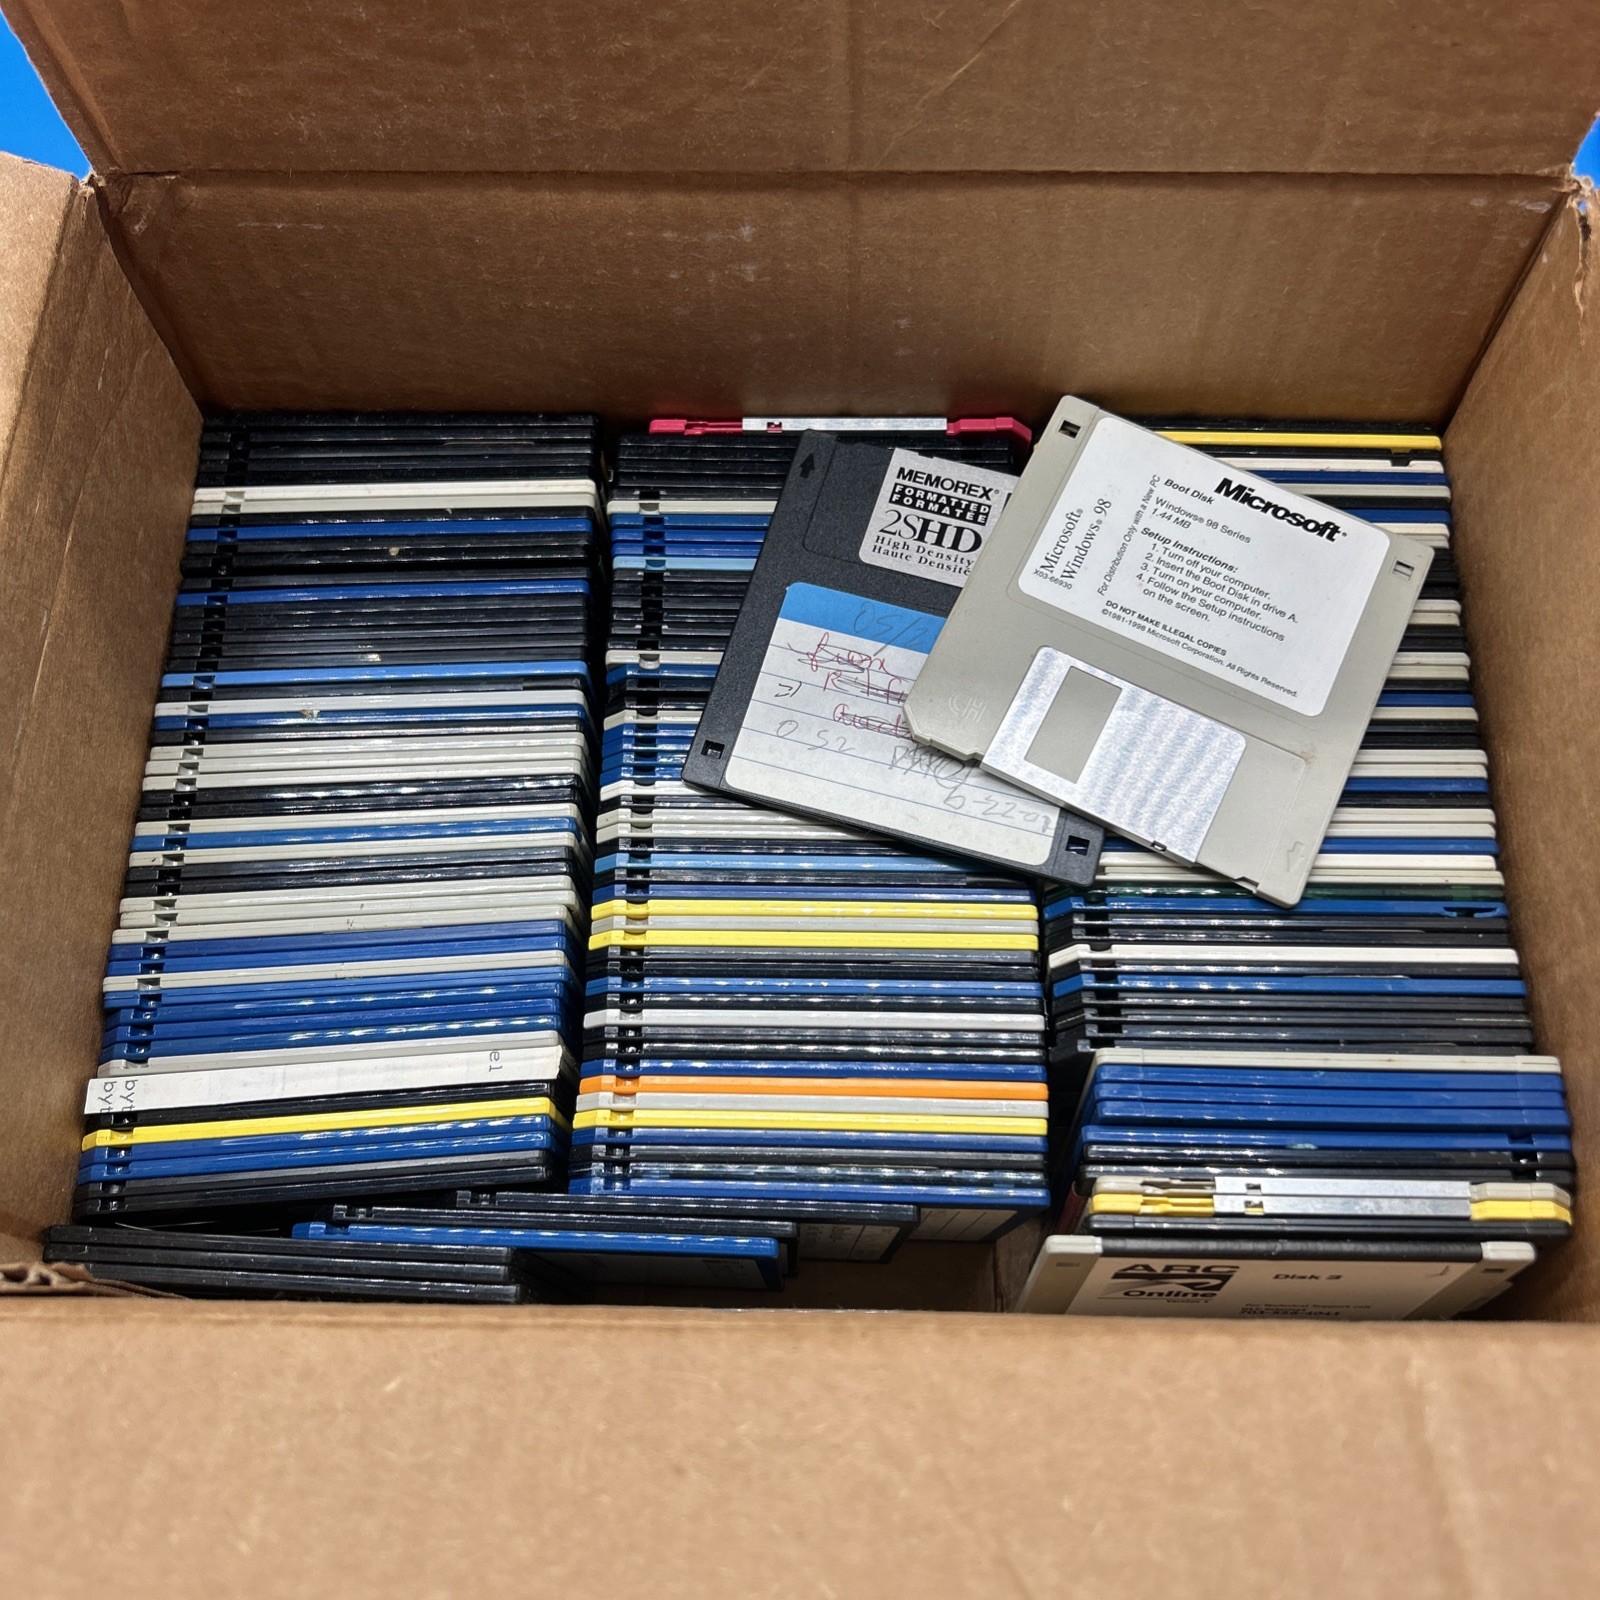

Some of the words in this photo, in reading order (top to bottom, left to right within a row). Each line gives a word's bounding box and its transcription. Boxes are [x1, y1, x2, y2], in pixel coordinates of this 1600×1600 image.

[894, 484, 990, 514] FORMATTED
[1093, 498, 1112, 517] 98
[1164, 478, 1190, 495] Boot
[1192, 489, 1215, 505] Disk
[879, 509, 982, 553] 2SHD
[1097, 581, 1109, 596] For
[1104, 543, 1128, 582] Distribution
[1123, 525, 1138, 543] Only
[1132, 509, 1143, 526] with
[1141, 488, 1155, 504] New
[1149, 474, 1161, 489] PC
[1152, 508, 1172, 523] 1.44
[1173, 516, 1192, 530] MB
[1206, 518, 1219, 531] 98
[1220, 525, 1252, 544] Series
[872, 545, 912, 561] Haute
[874, 535, 910, 551] High
[916, 545, 975, 567] Density
[1141, 527, 1171, 546] Setup
[1172, 540, 1239, 573] Instructions:
[1145, 552, 1154, 563] 2.
[1156, 556, 1184, 575] Insert
[1185, 568, 1201, 582] the
[1202, 575, 1226, 592] Boot
[1227, 586, 1249, 602] Disk
[1250, 596, 1261, 607] in
[1262, 601, 1287, 618] drive
[1288, 613, 1298, 624] A.
[1152, 543, 1159, 553] 1.
[1162, 547, 1184, 563] Turn
[1186, 556, 1200, 569] off
[1200, 562, 1226, 580] your
[1223, 573, 1271, 600] computer.
[1136, 572, 1145, 583] 4.
[1147, 576, 1180, 597] Follow
[1181, 590, 1196, 604] the
[1198, 598, 1227, 618] Setup
[1228, 611, 1285, 642] instructions
[1140, 562, 1149, 572] 3.
[1153, 567, 1175, 583] Turn
[1177, 578, 1190, 589] on
[1191, 583, 1217, 600] your
[1214, 593, 1262, 620] computer.
[1143, 589, 1156, 599] on
[1158, 592, 1174, 606] the
[1175, 601, 1211, 622] screen.
[1105, 600, 1118, 610] DO
[1119, 605, 1137, 618] NOT
[1137, 612, 1161, 628] MAKE
[1161, 623, 1195, 643] ILLEGAL
[1196, 638, 1227, 656] COPIES
[1146, 627, 1180, 647] Microsoft
[1181, 642, 1224, 666] Corporation.
[1226, 661, 1236, 671] All
[1237, 667, 1260, 682] Rights
[1260, 677, 1298, 698] Reserved.
[1118, 1263, 1240, 1274] ARC
[1123, 1290, 1217, 1298] Online
